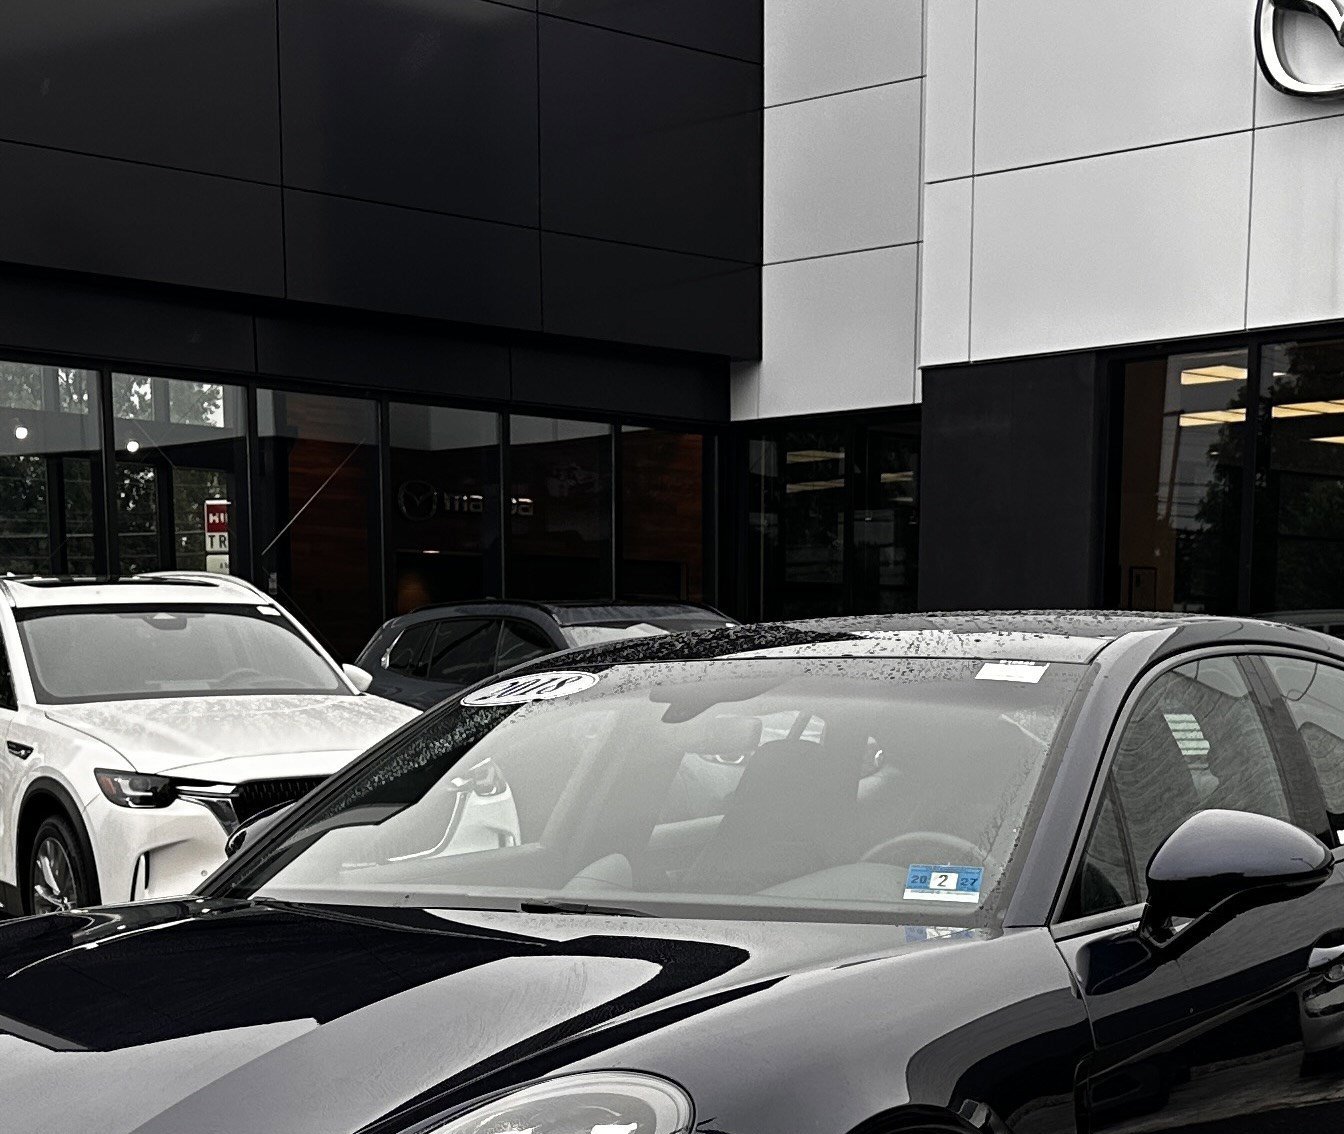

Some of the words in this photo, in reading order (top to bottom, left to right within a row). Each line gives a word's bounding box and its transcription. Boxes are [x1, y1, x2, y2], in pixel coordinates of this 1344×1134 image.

[208, 512, 228, 524] HI
[937, 874, 948, 887] 2
[960, 878, 979, 887] 27
